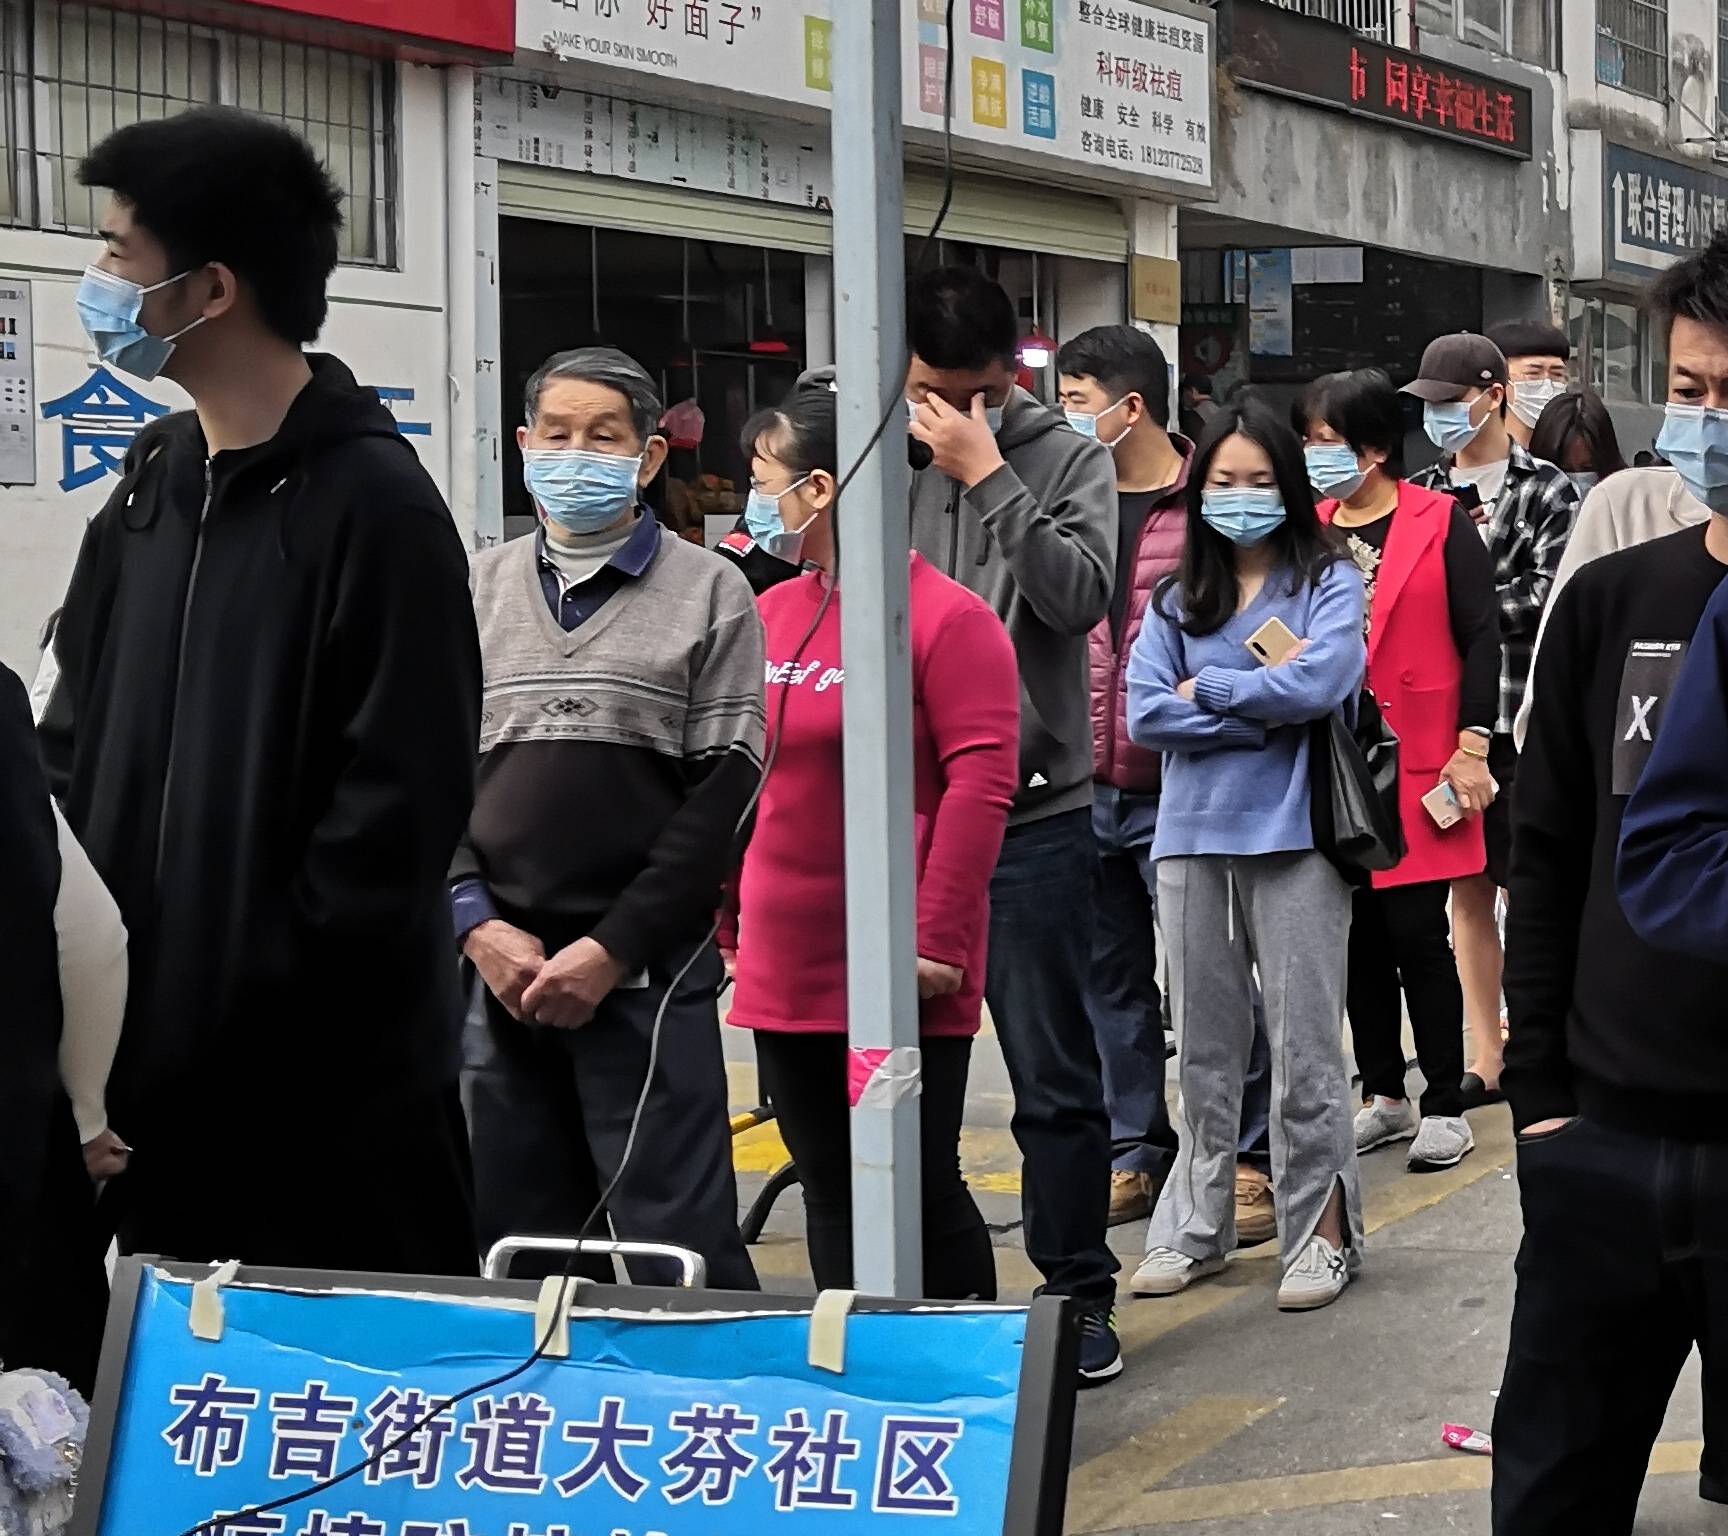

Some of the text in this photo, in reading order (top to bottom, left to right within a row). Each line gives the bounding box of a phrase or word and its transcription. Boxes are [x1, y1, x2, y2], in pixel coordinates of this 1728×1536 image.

[552, 30, 678, 69] MAKE YOUR SKIN SMOOTH
[1096, 49, 1184, 102] 科研级祛痘
[1080, 93, 1105, 120] 健康
[1117, 102, 1140, 129] 安全
[1151, 110, 1174, 136] 科学
[161, 1375, 962, 1515] 布吉街道大芬社区
